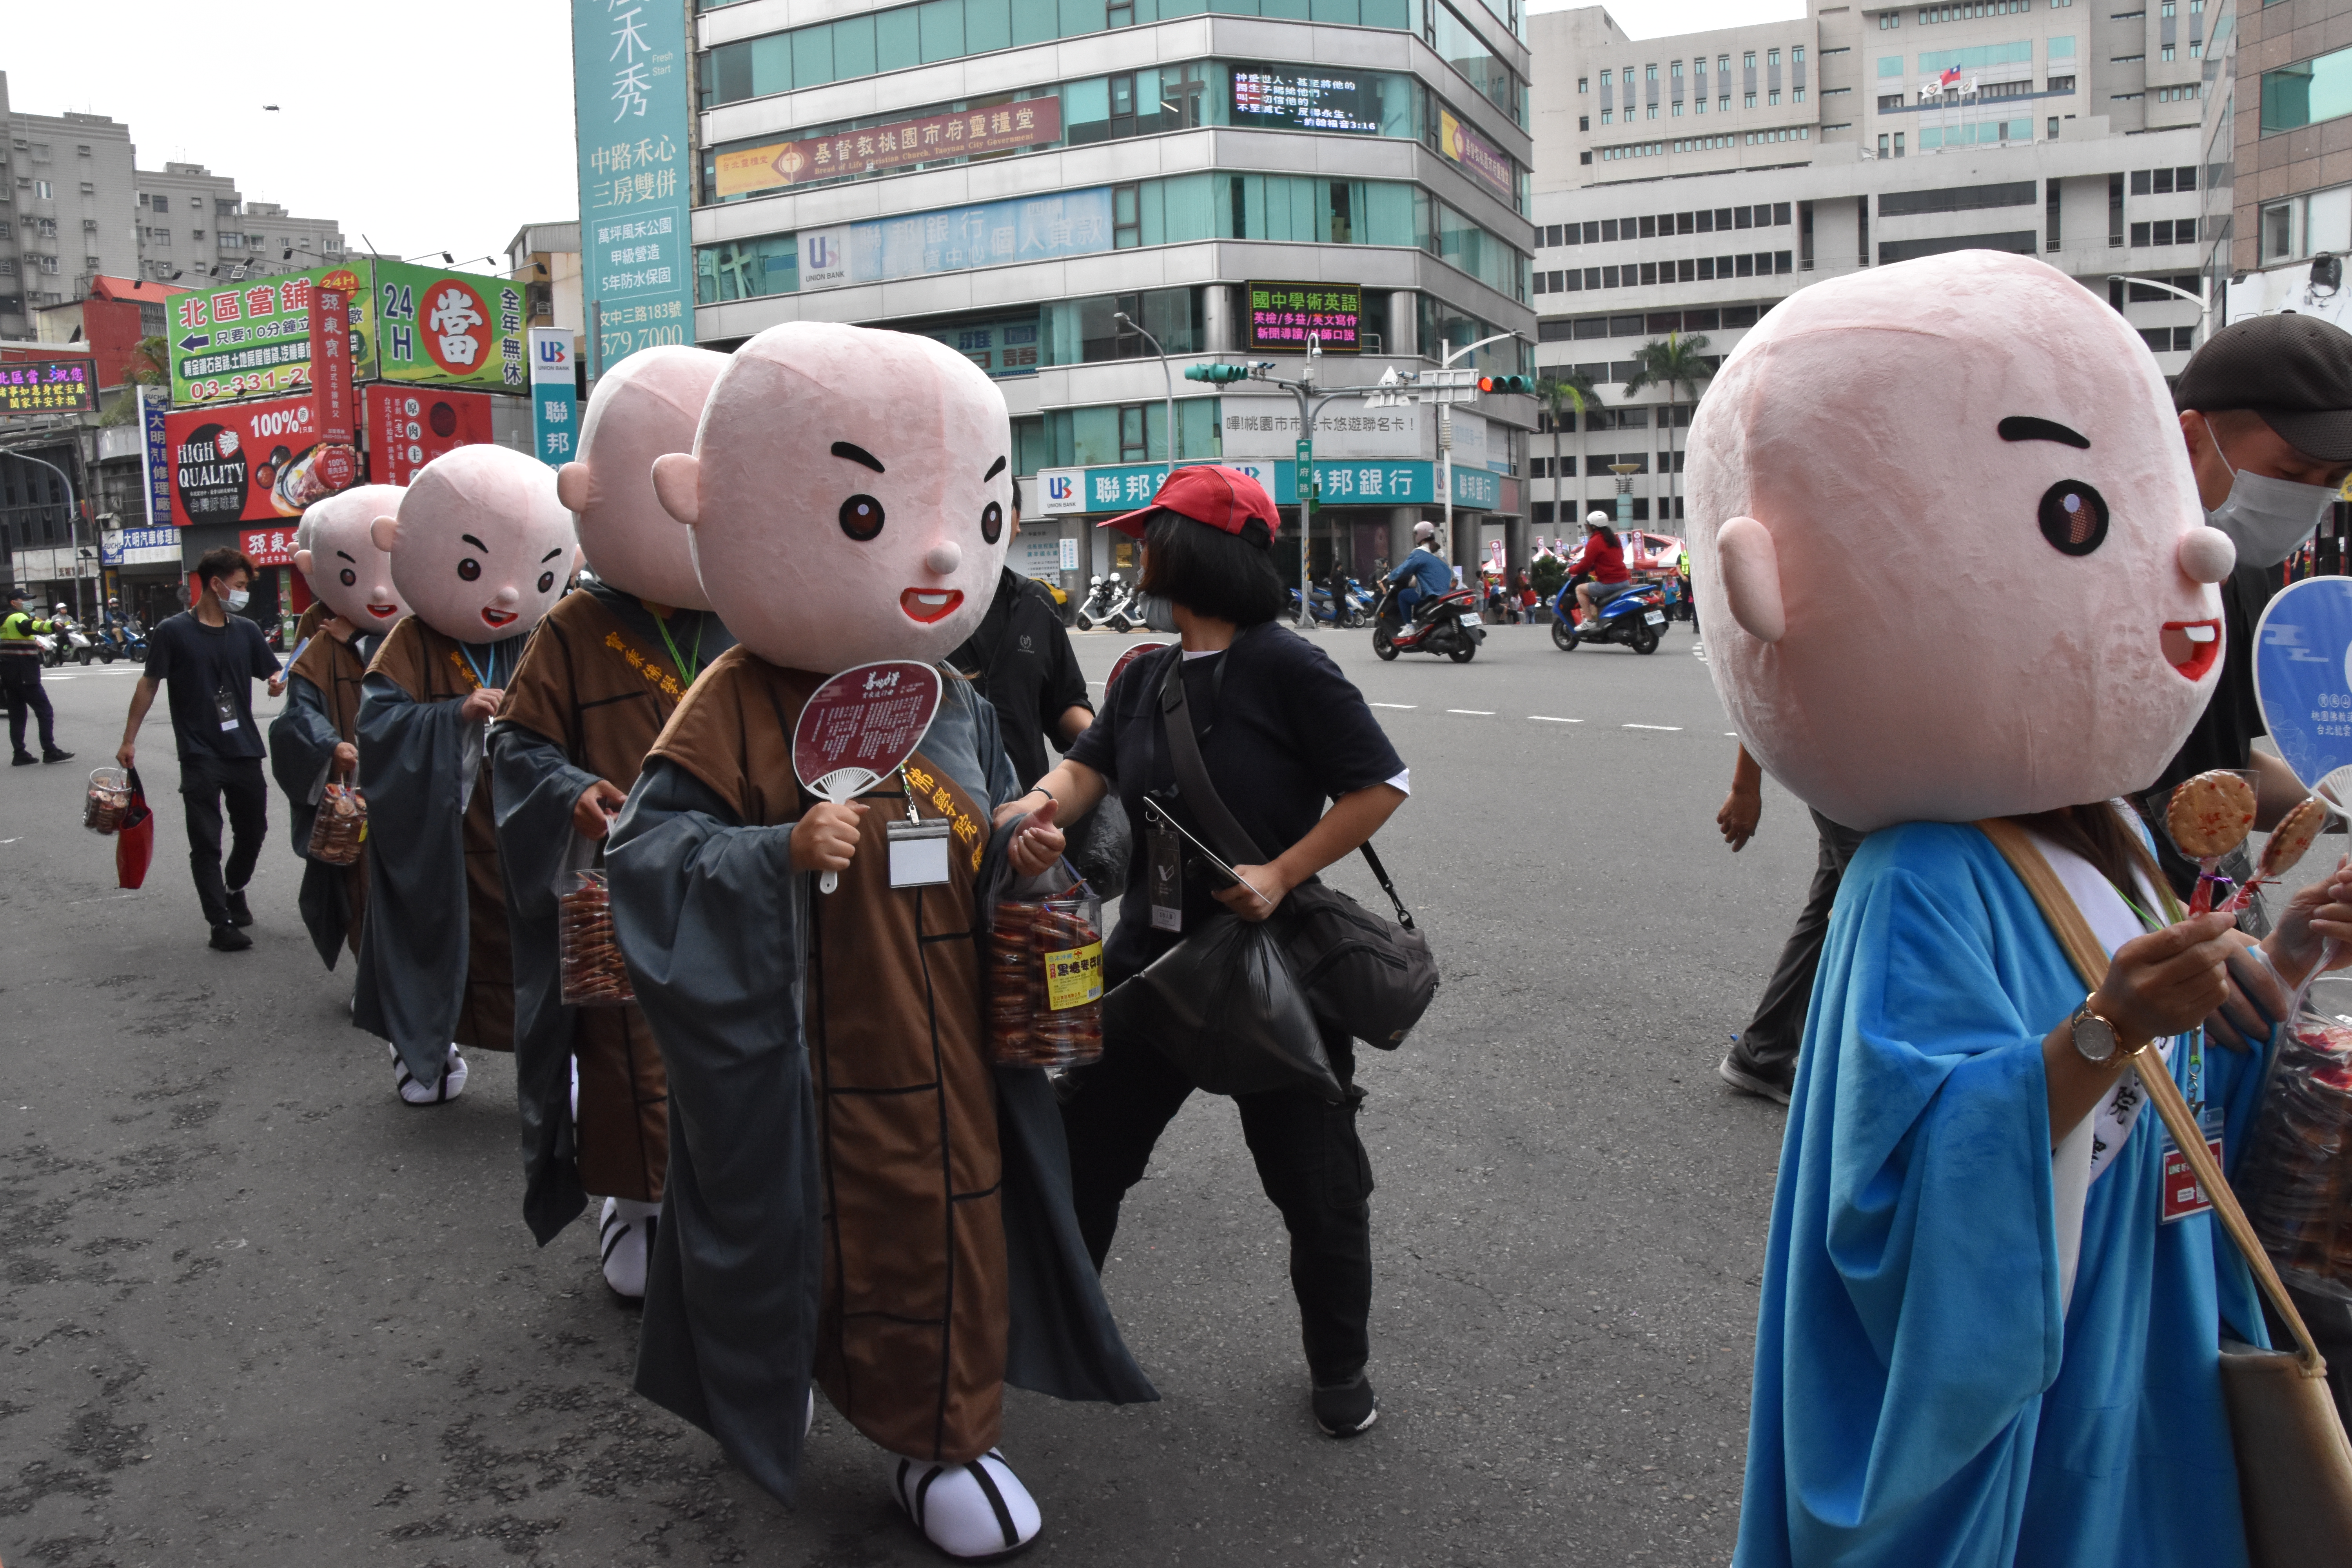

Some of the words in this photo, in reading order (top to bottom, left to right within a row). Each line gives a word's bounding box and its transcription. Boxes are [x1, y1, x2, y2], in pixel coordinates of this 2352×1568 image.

[608, 0, 652, 123] 禾秀
[652, 51, 673, 63] Fresh
[653, 65, 671, 76] Start
[815, 108, 1034, 164] 基督教桃園市府靈糧堂
[591, 134, 676, 175] 中路禾心
[815, 165, 835, 175] Bread
[866, 156, 899, 165] Christian
[935, 144, 964, 155] Taoyuan
[987, 133, 1034, 146] Government
[592, 168, 677, 208] 三房雙併
[598, 217, 671, 244] 萬坪風禾公園
[991, 216, 1104, 257] 個人貸款
[611, 243, 660, 266] 甲級營造
[603, 267, 671, 291] 5年防水保固
[806, 274, 825, 282] UNION
[827, 271, 844, 279] BANK
[383, 283, 415, 321] 24
[600, 301, 682, 327] 文中三路183號
[1253, 291, 1357, 311] 國中學術英語
[321, 294, 342, 357] 孫東寶
[430, 289, 483, 365] 當
[1254, 312, 1357, 327] 英檢/多益/英文寫作
[391, 324, 413, 361] H
[500, 287, 523, 385] 全年無休
[601, 331, 632, 356] 379
[638, 324, 682, 352] 7000
[251, 409, 299, 438] 100%
[544, 401, 569, 470] 聯邦
[177, 441, 215, 464] HIGH
[178, 463, 245, 487] QUALITY
[1299, 452, 1309, 493] 縣府路
[1459, 474, 1490, 502] 聯邦銀行
